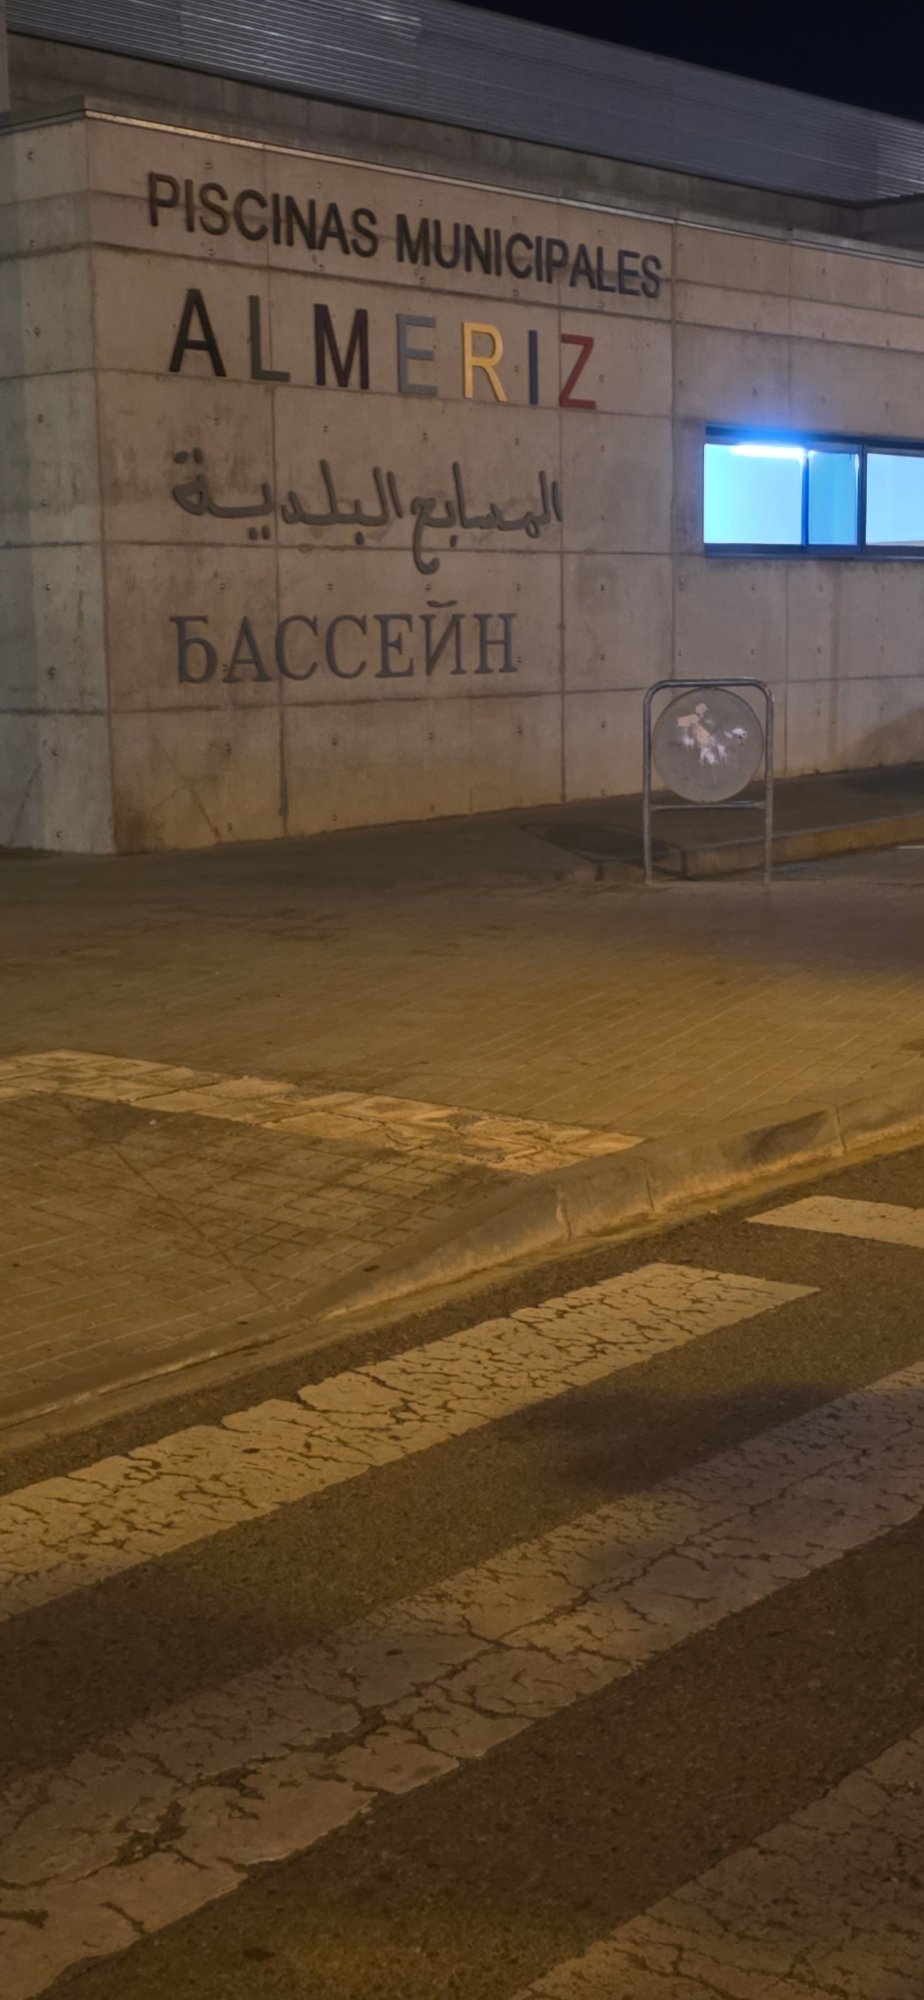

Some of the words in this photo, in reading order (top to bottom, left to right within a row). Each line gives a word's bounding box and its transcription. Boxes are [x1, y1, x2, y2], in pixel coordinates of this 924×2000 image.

[148, 171, 379, 258] PISCINAS
[396, 213, 663, 299] MUNICIPALES
[168, 288, 597, 410] ALMERIZ
[172, 447, 404, 546] البلدية
[169, 600, 519, 684] БАССЕЙН
